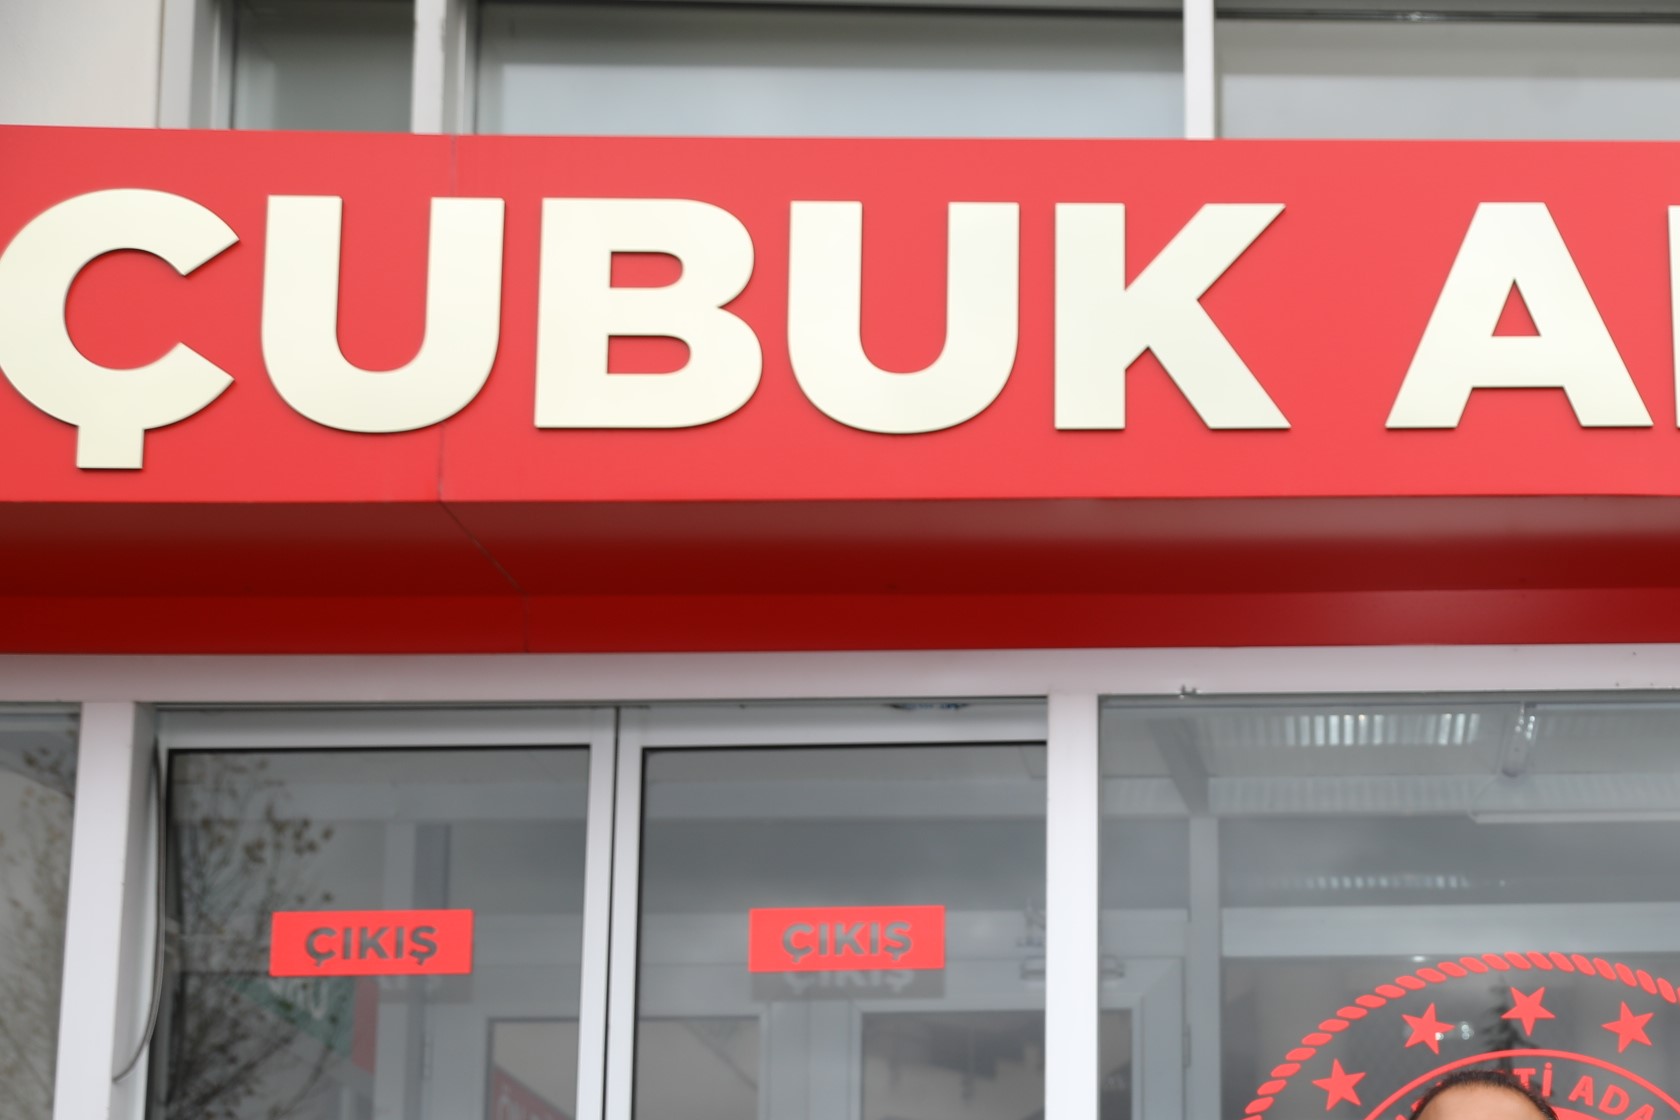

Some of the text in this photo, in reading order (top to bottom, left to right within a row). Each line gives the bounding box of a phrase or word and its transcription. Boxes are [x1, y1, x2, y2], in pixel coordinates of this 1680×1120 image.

[0, 188, 1291, 471] ÇUBUK
[304, 925, 438, 967] ÇIKIŞ
[782, 920, 914, 961] ÇIKIŞ
